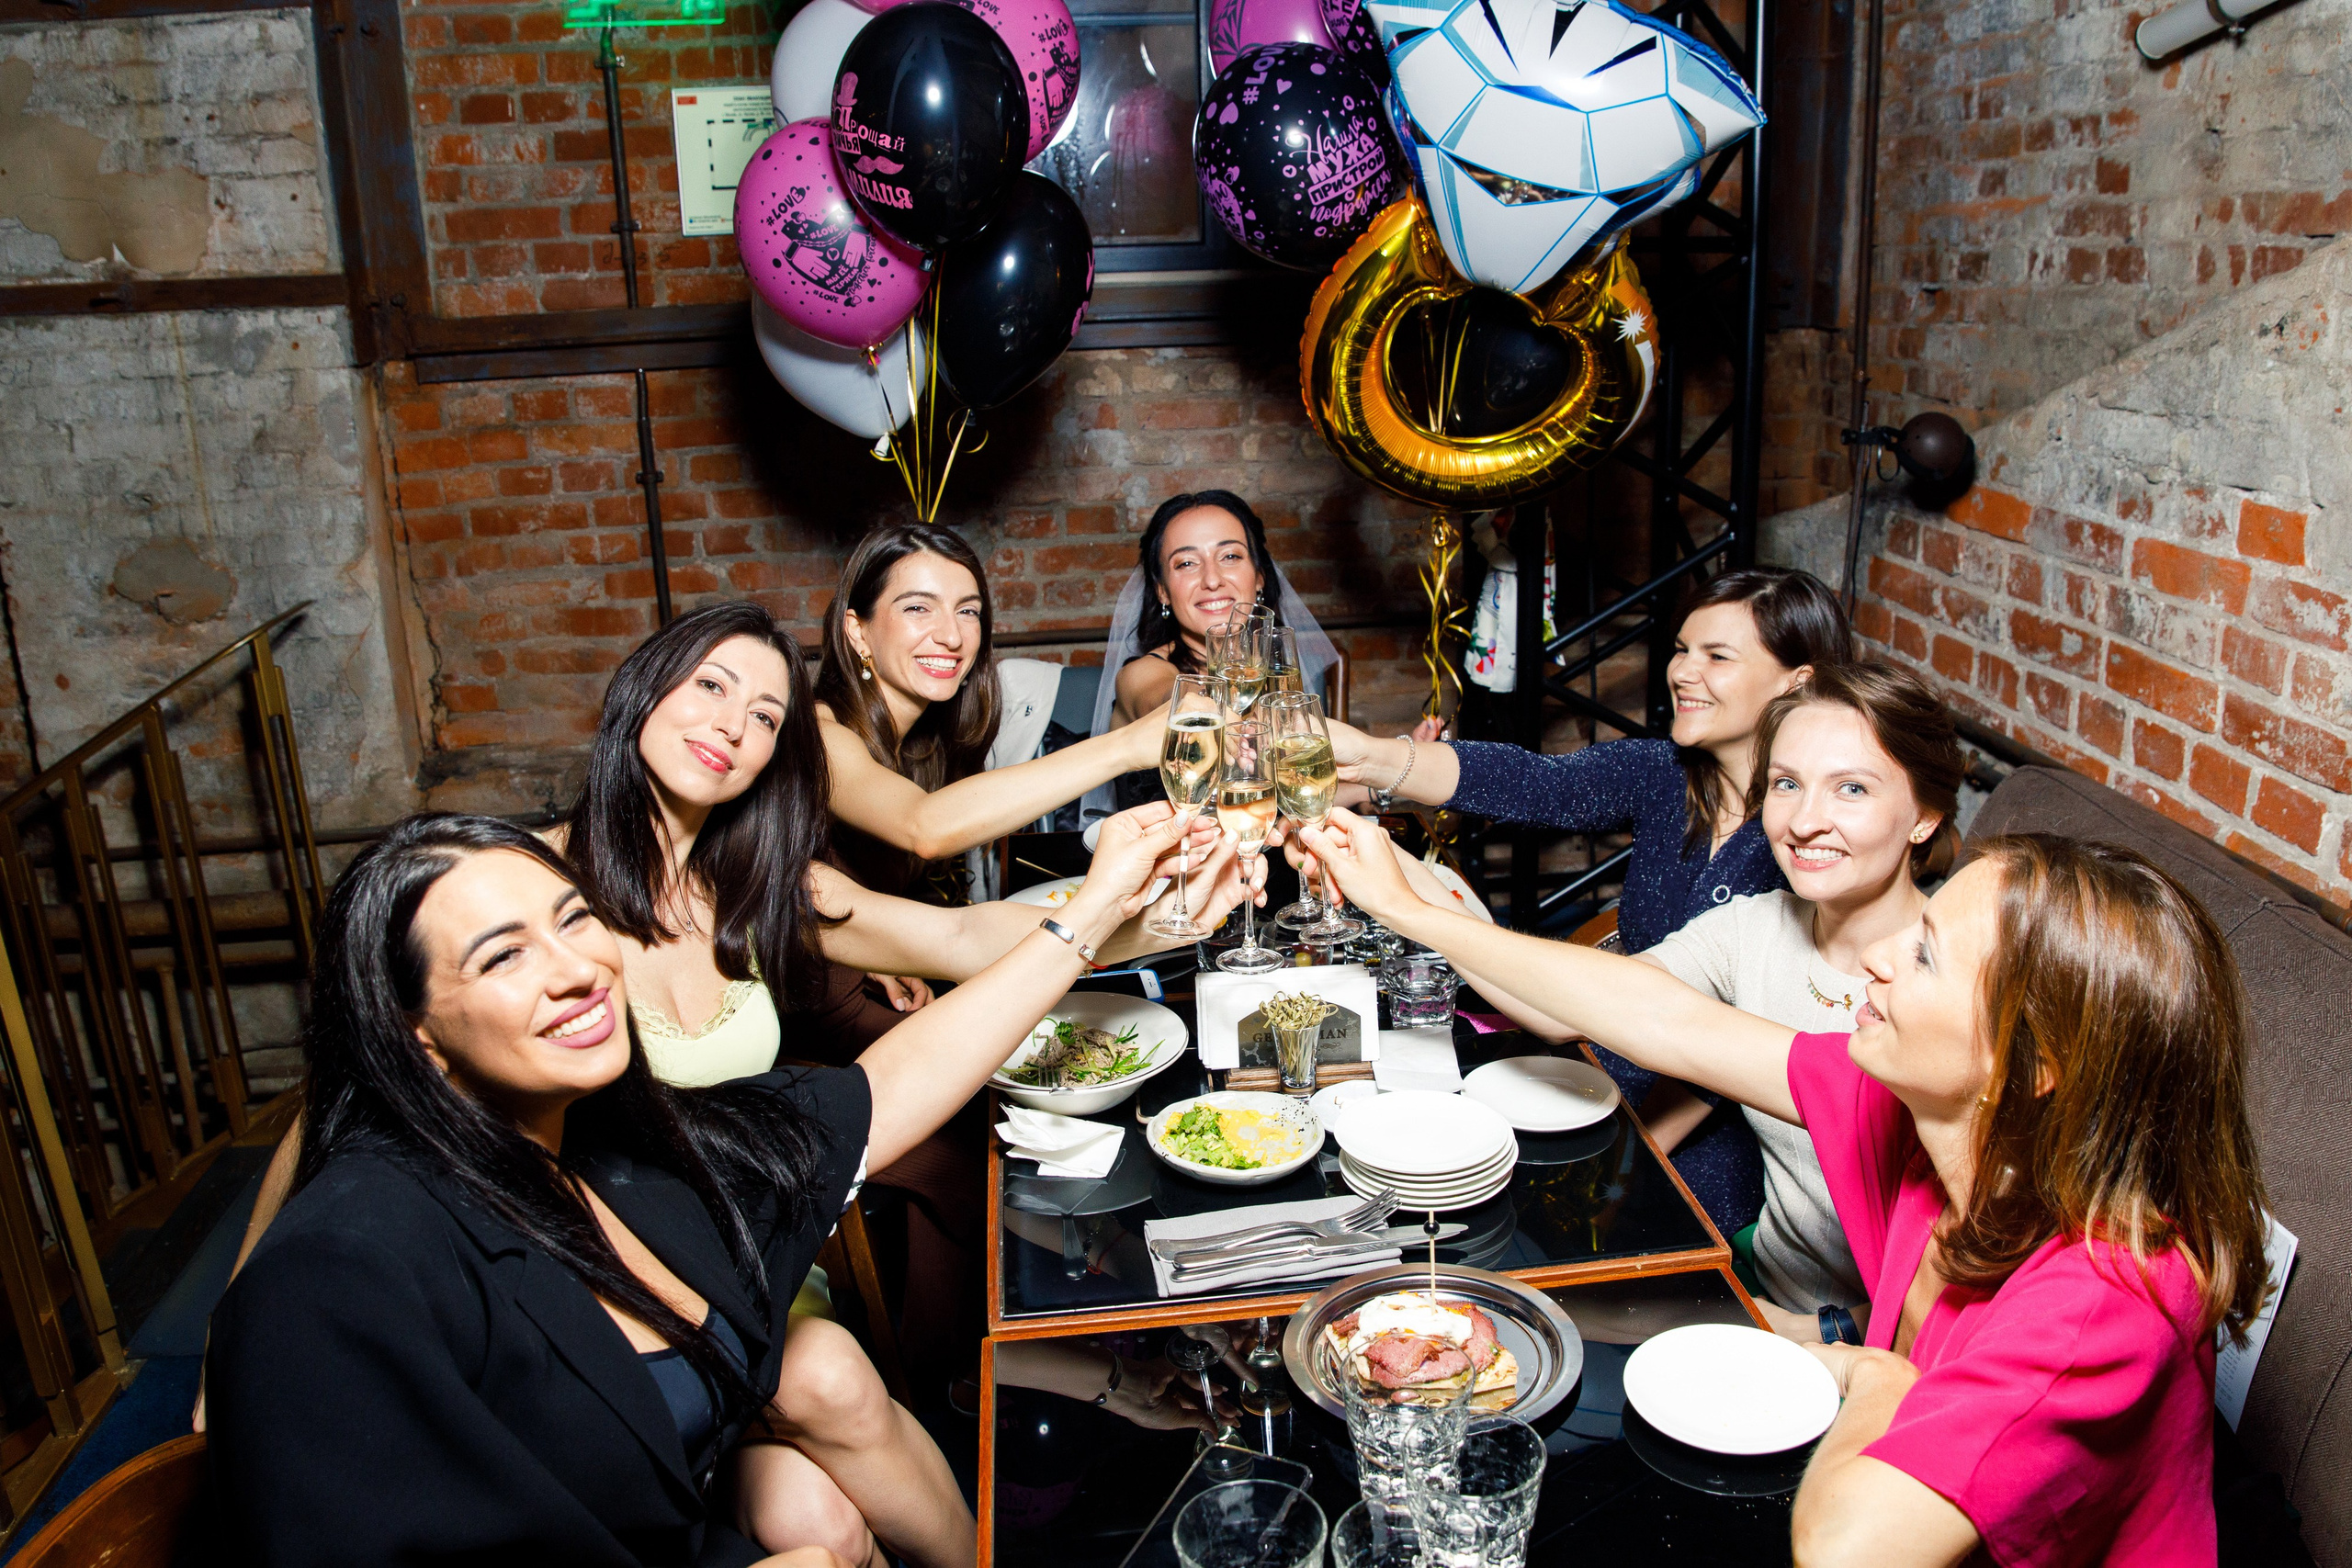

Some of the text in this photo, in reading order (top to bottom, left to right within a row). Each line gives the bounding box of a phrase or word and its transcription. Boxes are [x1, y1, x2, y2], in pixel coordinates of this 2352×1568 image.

[977, 0, 1000, 16] LOVE
[1242, 44, 1286, 105] #LOV
[1307, 132, 1376, 185] МУЖА
[766, 186, 807, 227] #LOVE
[812, 289, 840, 304] #LOVE
